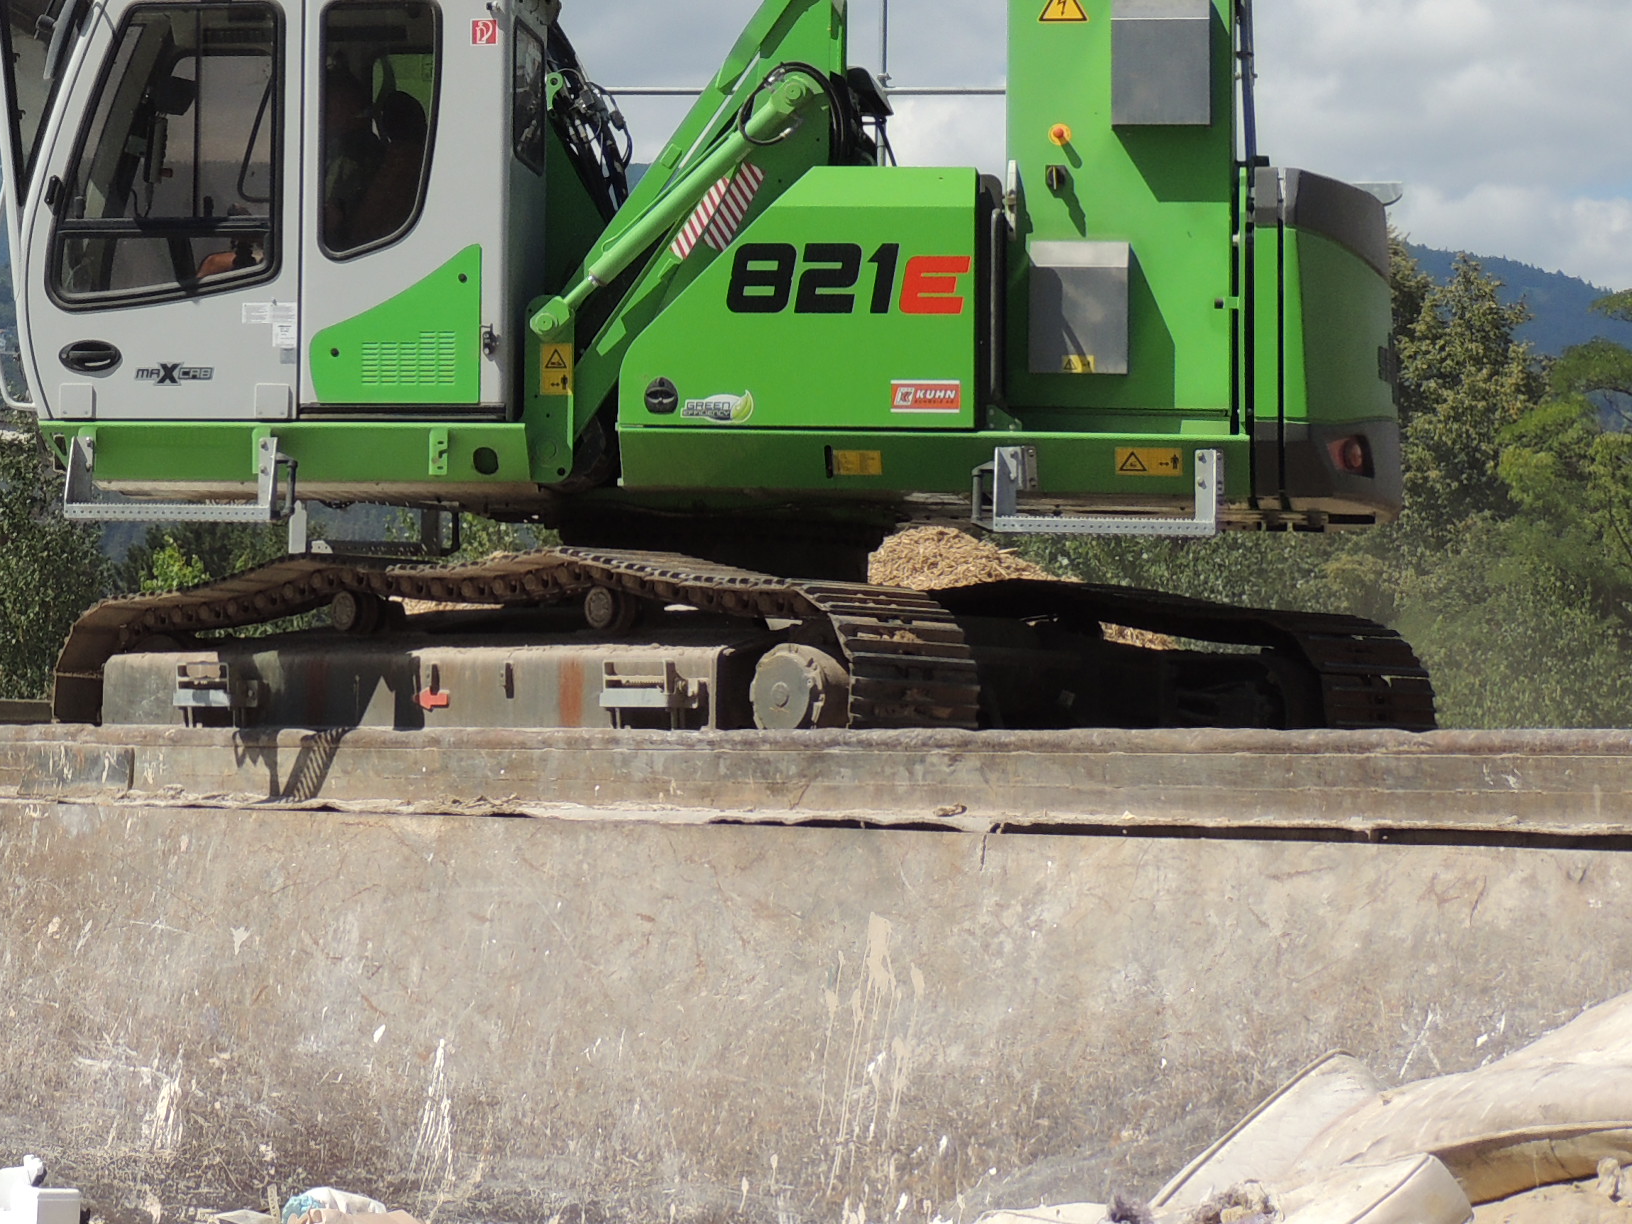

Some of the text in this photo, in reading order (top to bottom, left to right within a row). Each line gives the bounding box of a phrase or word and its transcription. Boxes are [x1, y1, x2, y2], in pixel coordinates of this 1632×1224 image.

[726, 242, 971, 314] 821E
[915, 389, 956, 399] KUHN
[687, 401, 731, 411] GREEN
